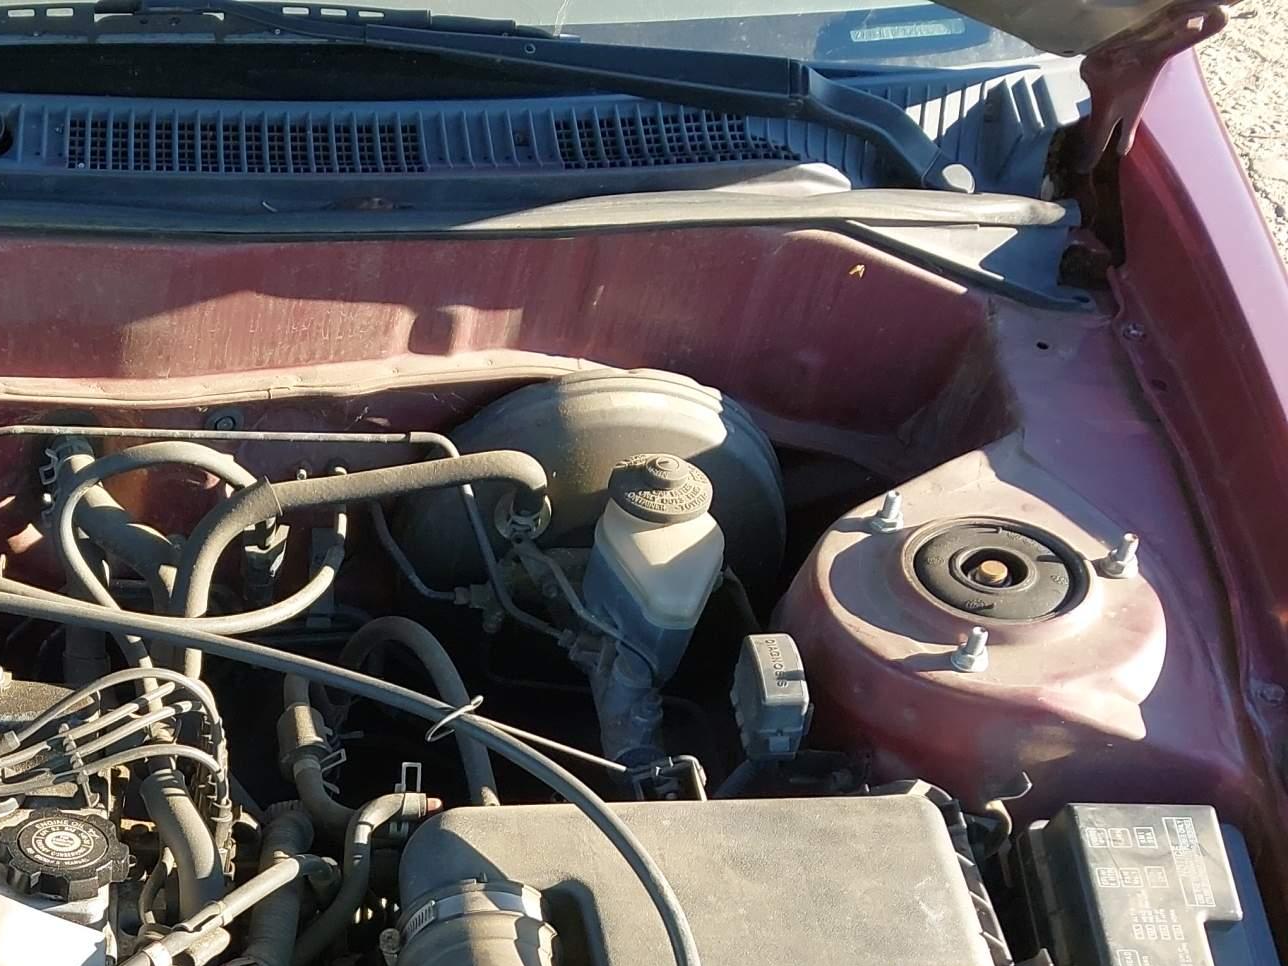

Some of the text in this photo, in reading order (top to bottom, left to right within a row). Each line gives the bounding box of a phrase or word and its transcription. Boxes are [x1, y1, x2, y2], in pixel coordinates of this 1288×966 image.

[765, 639, 788, 688] DIAGNOSIS
[35, 820, 86, 830] ENGINE OIL
